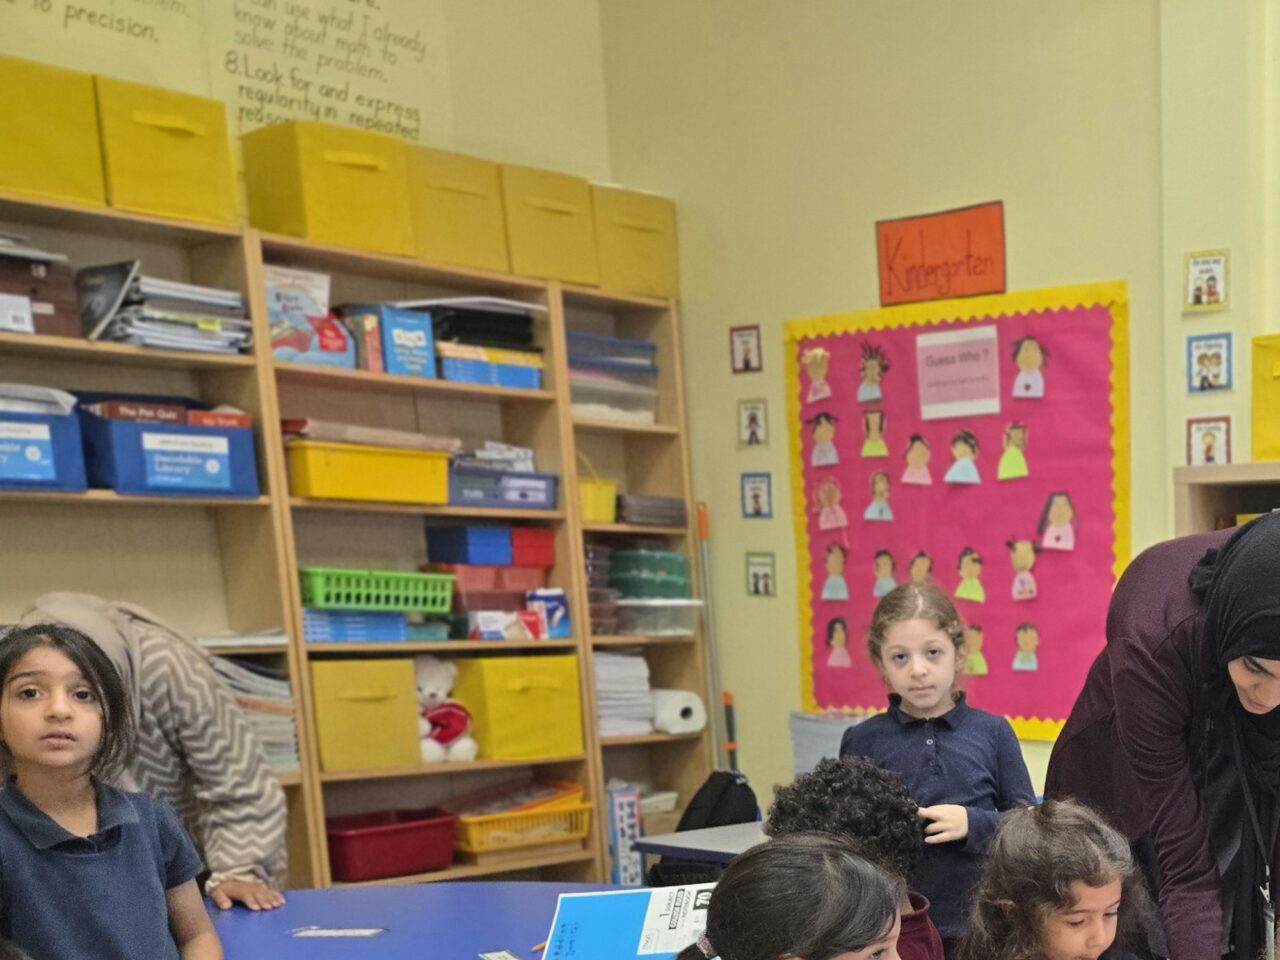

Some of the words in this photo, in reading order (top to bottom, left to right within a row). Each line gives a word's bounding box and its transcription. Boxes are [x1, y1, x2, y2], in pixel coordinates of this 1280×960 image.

[63, 4, 159, 43] precision.
[316, 53, 389, 84] problem.
[318, 81, 350, 102] and
[354, 93, 421, 122] express
[349, 110, 421, 141] repeated
[696, 892, 713, 907] 70
